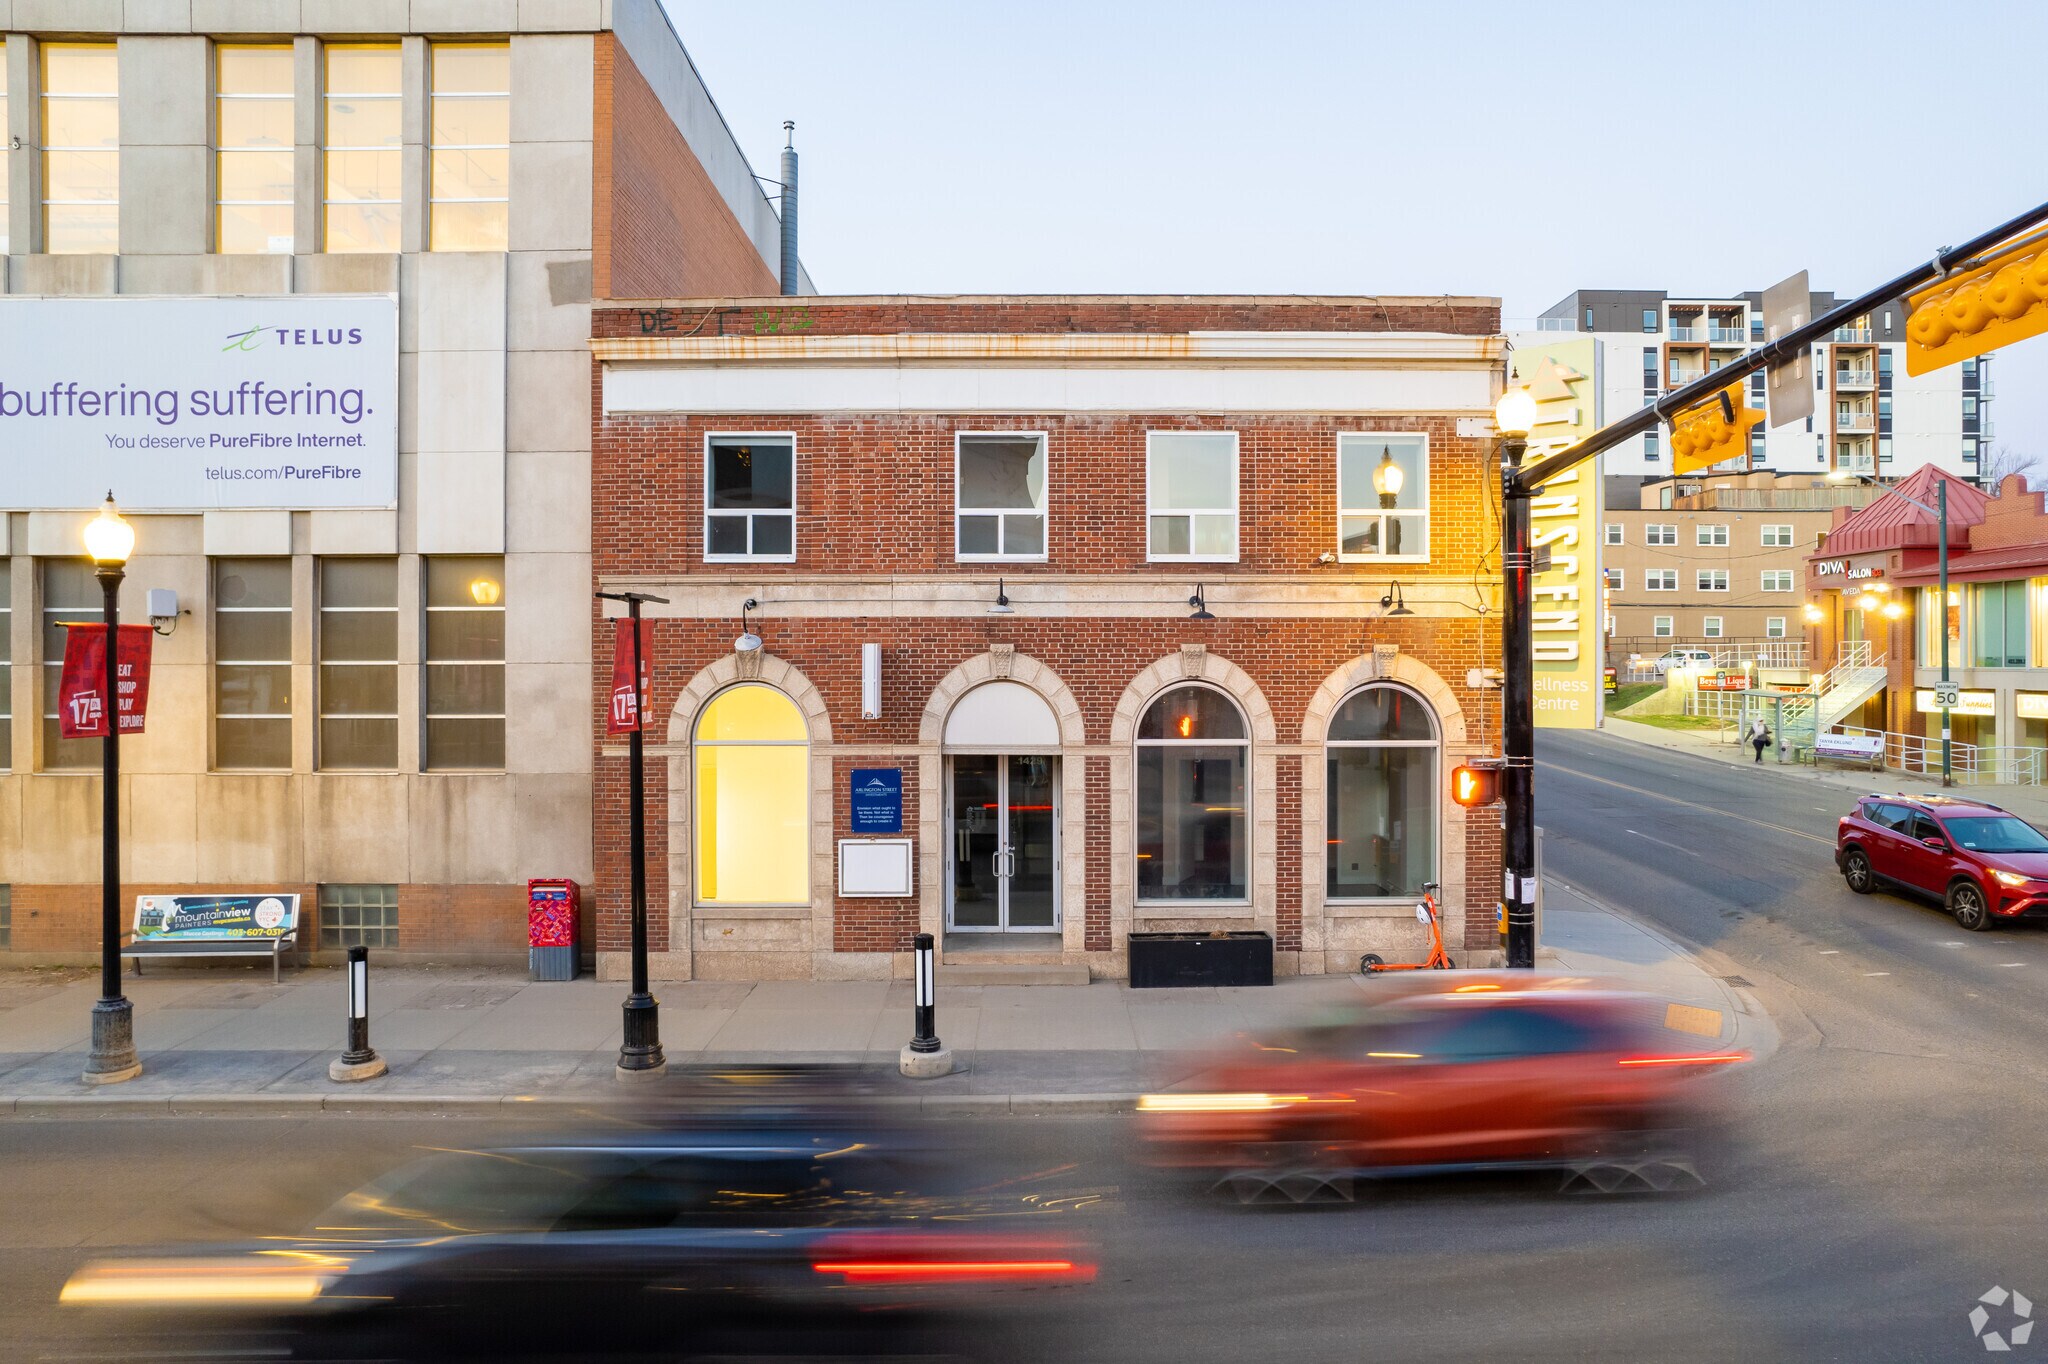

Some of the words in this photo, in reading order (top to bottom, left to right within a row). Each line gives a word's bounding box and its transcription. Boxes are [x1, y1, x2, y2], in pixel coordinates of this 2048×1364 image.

[276, 327, 363, 345] TELUS
[0, 381, 179, 425] buffering
[189, 381, 374, 424] suffering.
[105, 433, 136, 449] You
[139, 433, 205, 449] deserve
[209, 432, 293, 448] PureFibre
[297, 432, 366, 448] Internet.
[205, 465, 362, 480] telus.com/PureFibre
[1819, 561, 1845, 575] DIVA
[1847, 567, 1872, 580] SALON
[1842, 587, 1860, 596] AVEDA
[118, 664, 133, 676] EAT
[118, 682, 136, 693] SHOP
[1533, 676, 1589, 692] ellness
[1699, 676, 1717, 686] Beyo
[120, 698, 134, 710] PLAY
[1936, 691, 1957, 704] 50
[70, 698, 90, 724] 17
[613, 693, 627, 720] 17
[120, 715, 144, 728] EXPLORE
[174, 907, 251, 923] mountainview
[175, 920, 212, 929] PAINTERS
